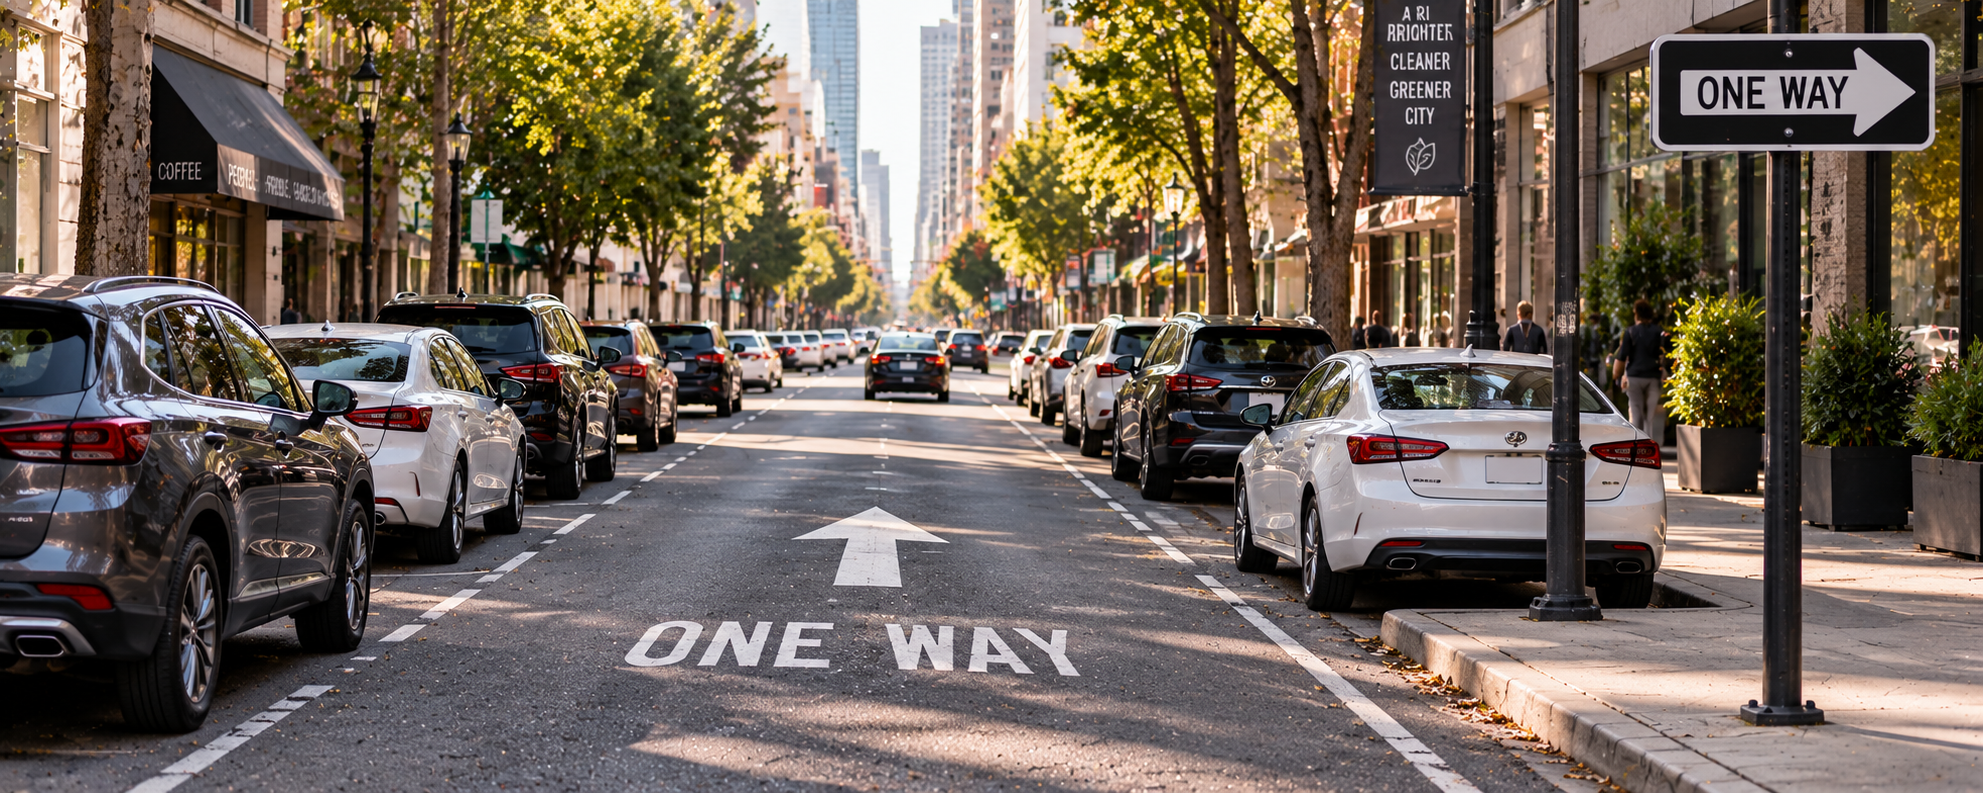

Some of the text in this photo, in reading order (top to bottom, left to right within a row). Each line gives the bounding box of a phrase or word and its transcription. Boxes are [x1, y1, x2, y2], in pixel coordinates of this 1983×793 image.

[1402, 6, 1411, 21] A
[1390, 52, 1450, 70] CLEANER
[1389, 80, 1451, 99] GREENER
[1697, 76, 1849, 110] ONE WAY
[1405, 107, 1435, 125] CITY
[158, 162, 202, 181] COFFEE
[624, 620, 1081, 677] ONE WAY
